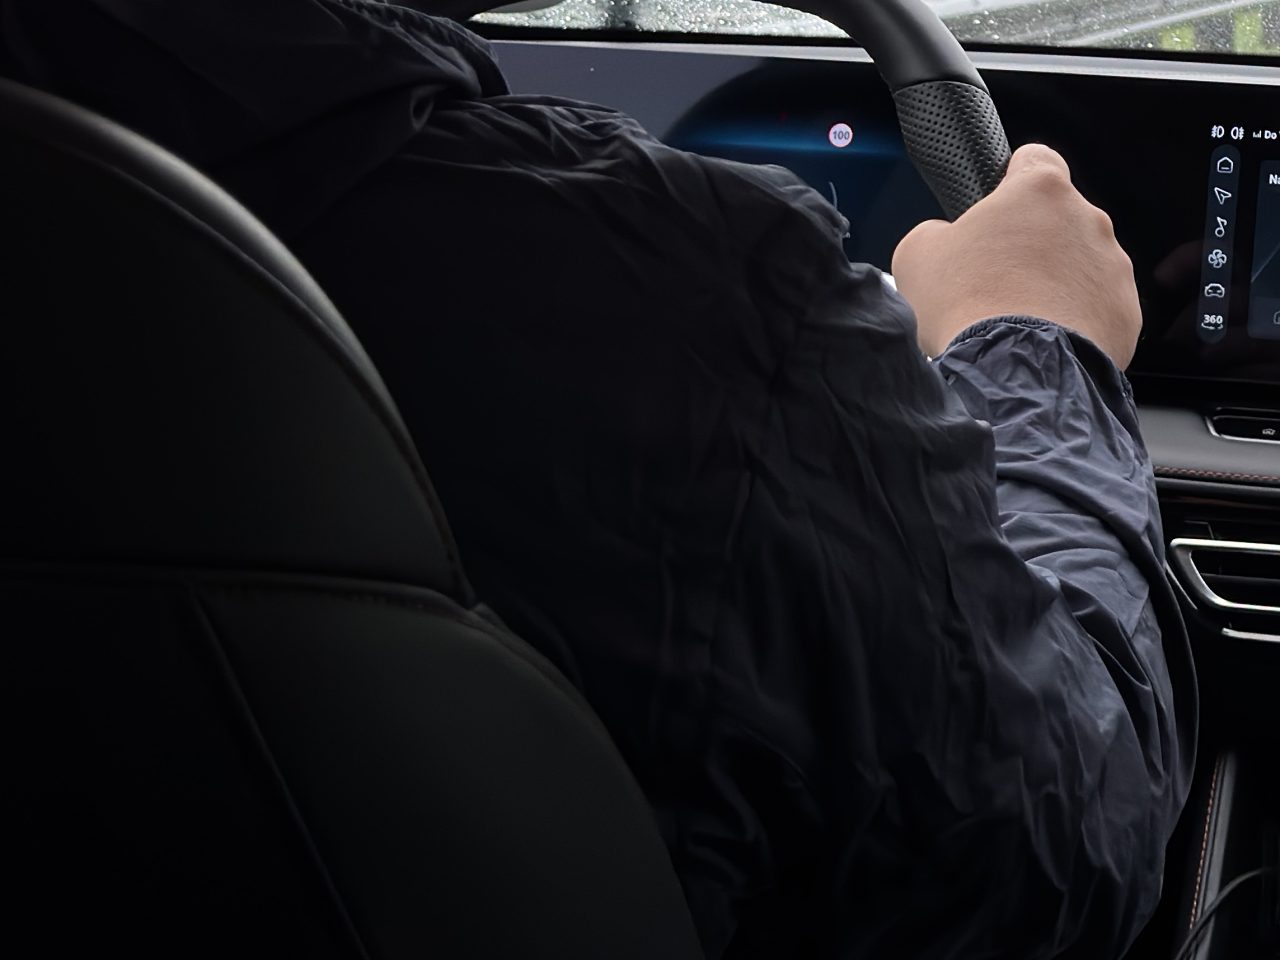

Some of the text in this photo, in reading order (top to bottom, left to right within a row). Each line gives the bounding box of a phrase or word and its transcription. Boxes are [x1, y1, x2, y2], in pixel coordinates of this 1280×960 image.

[833, 130, 850, 140] 100
[1264, 130, 1277, 139] Do
[1203, 315, 1223, 324] 360
